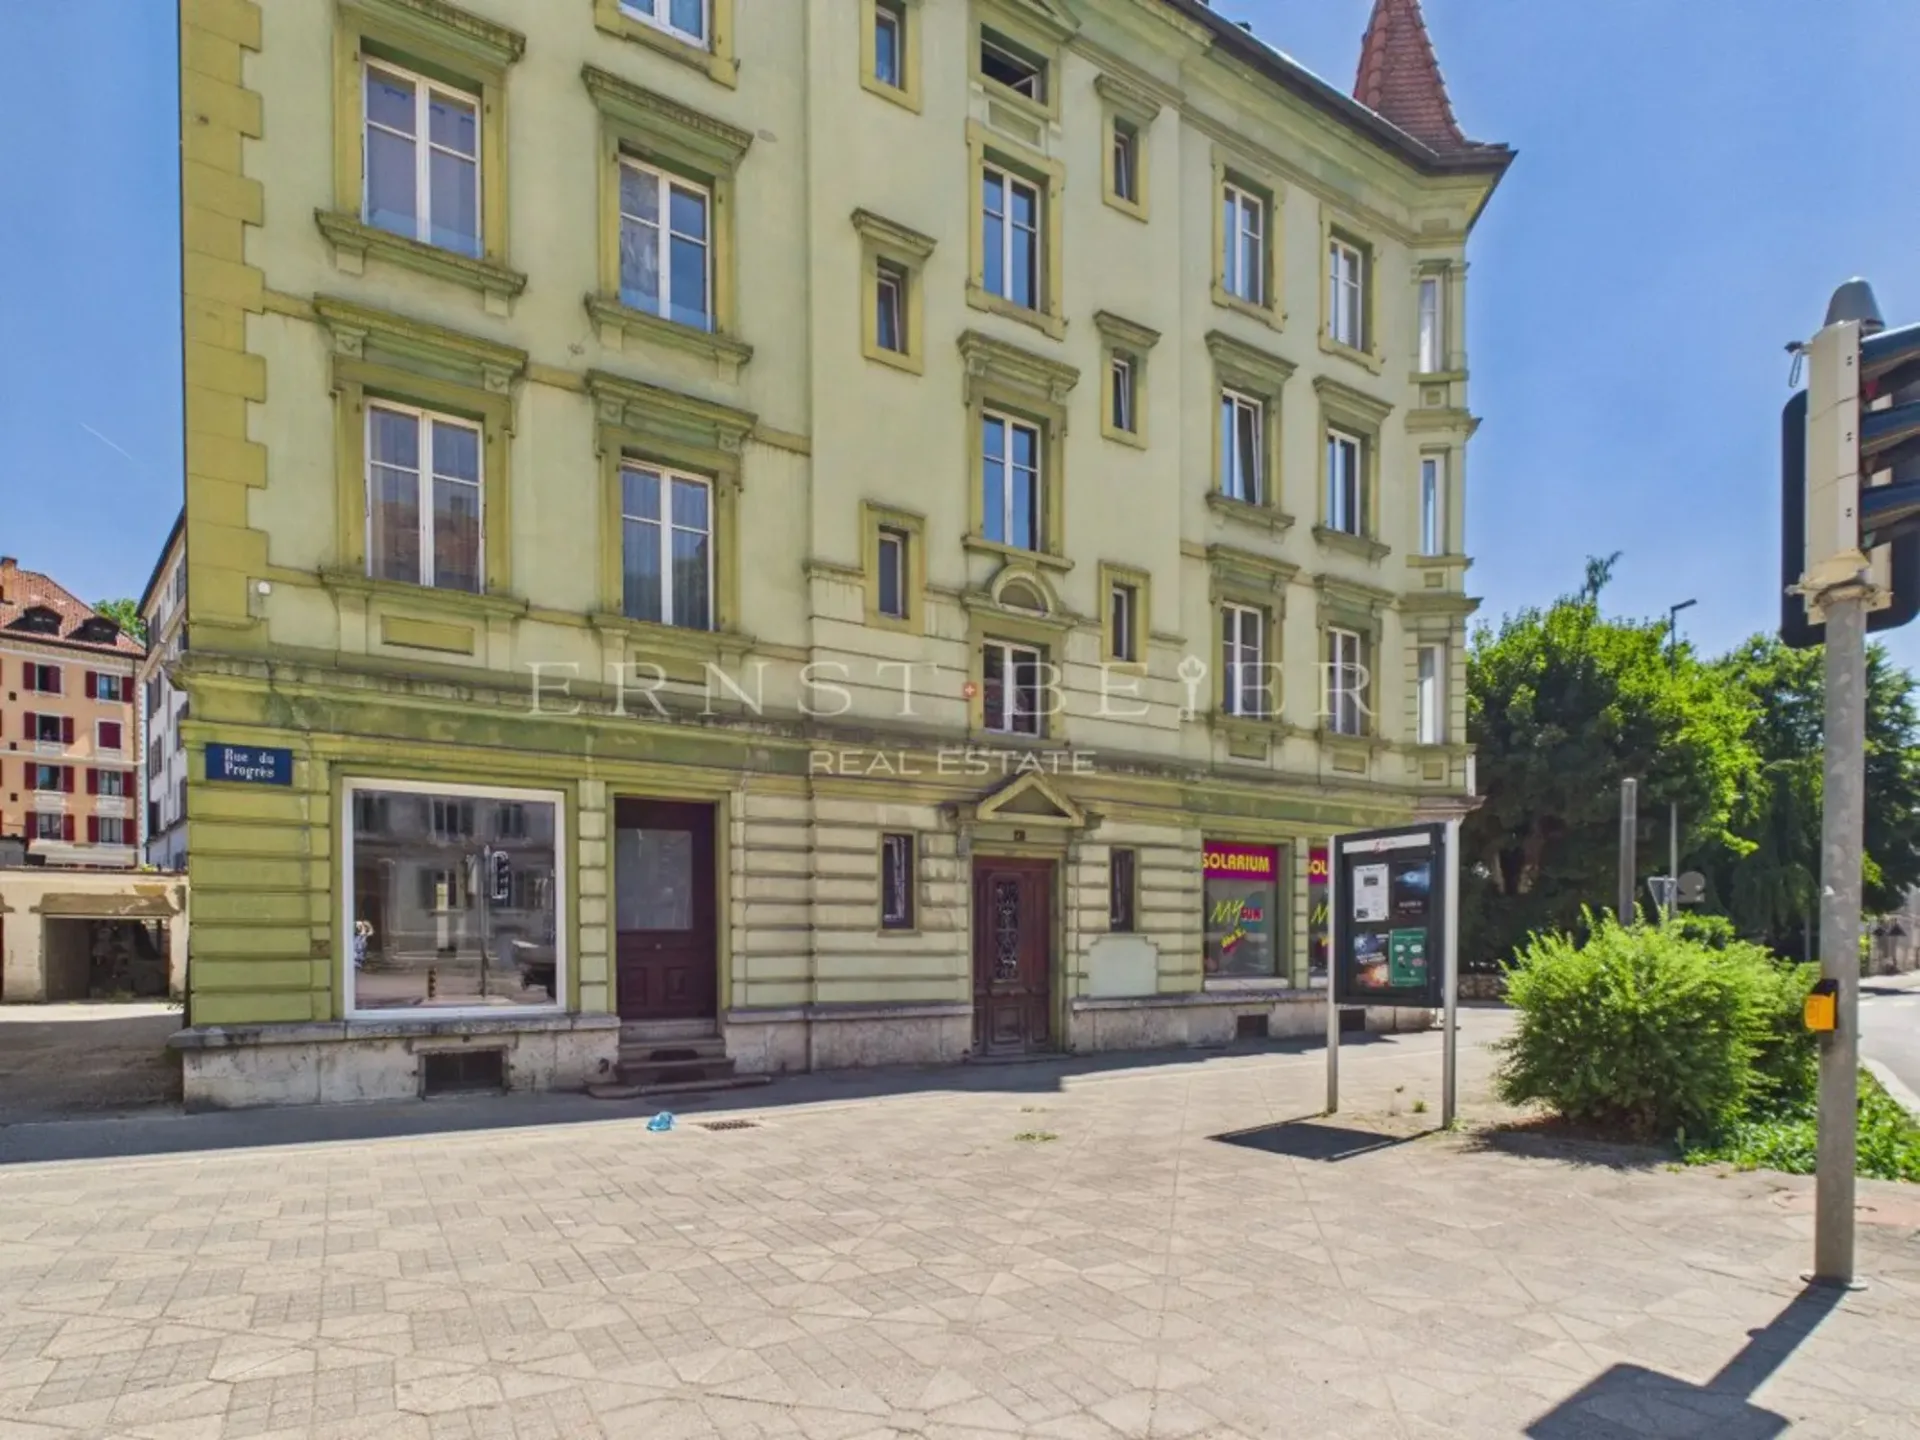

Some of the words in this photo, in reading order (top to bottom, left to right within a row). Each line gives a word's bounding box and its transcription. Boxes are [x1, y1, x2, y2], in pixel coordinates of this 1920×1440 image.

[224, 748, 249, 762] Rue
[259, 752, 275, 765] du
[1203, 852, 1270, 873] SOLARIUM
